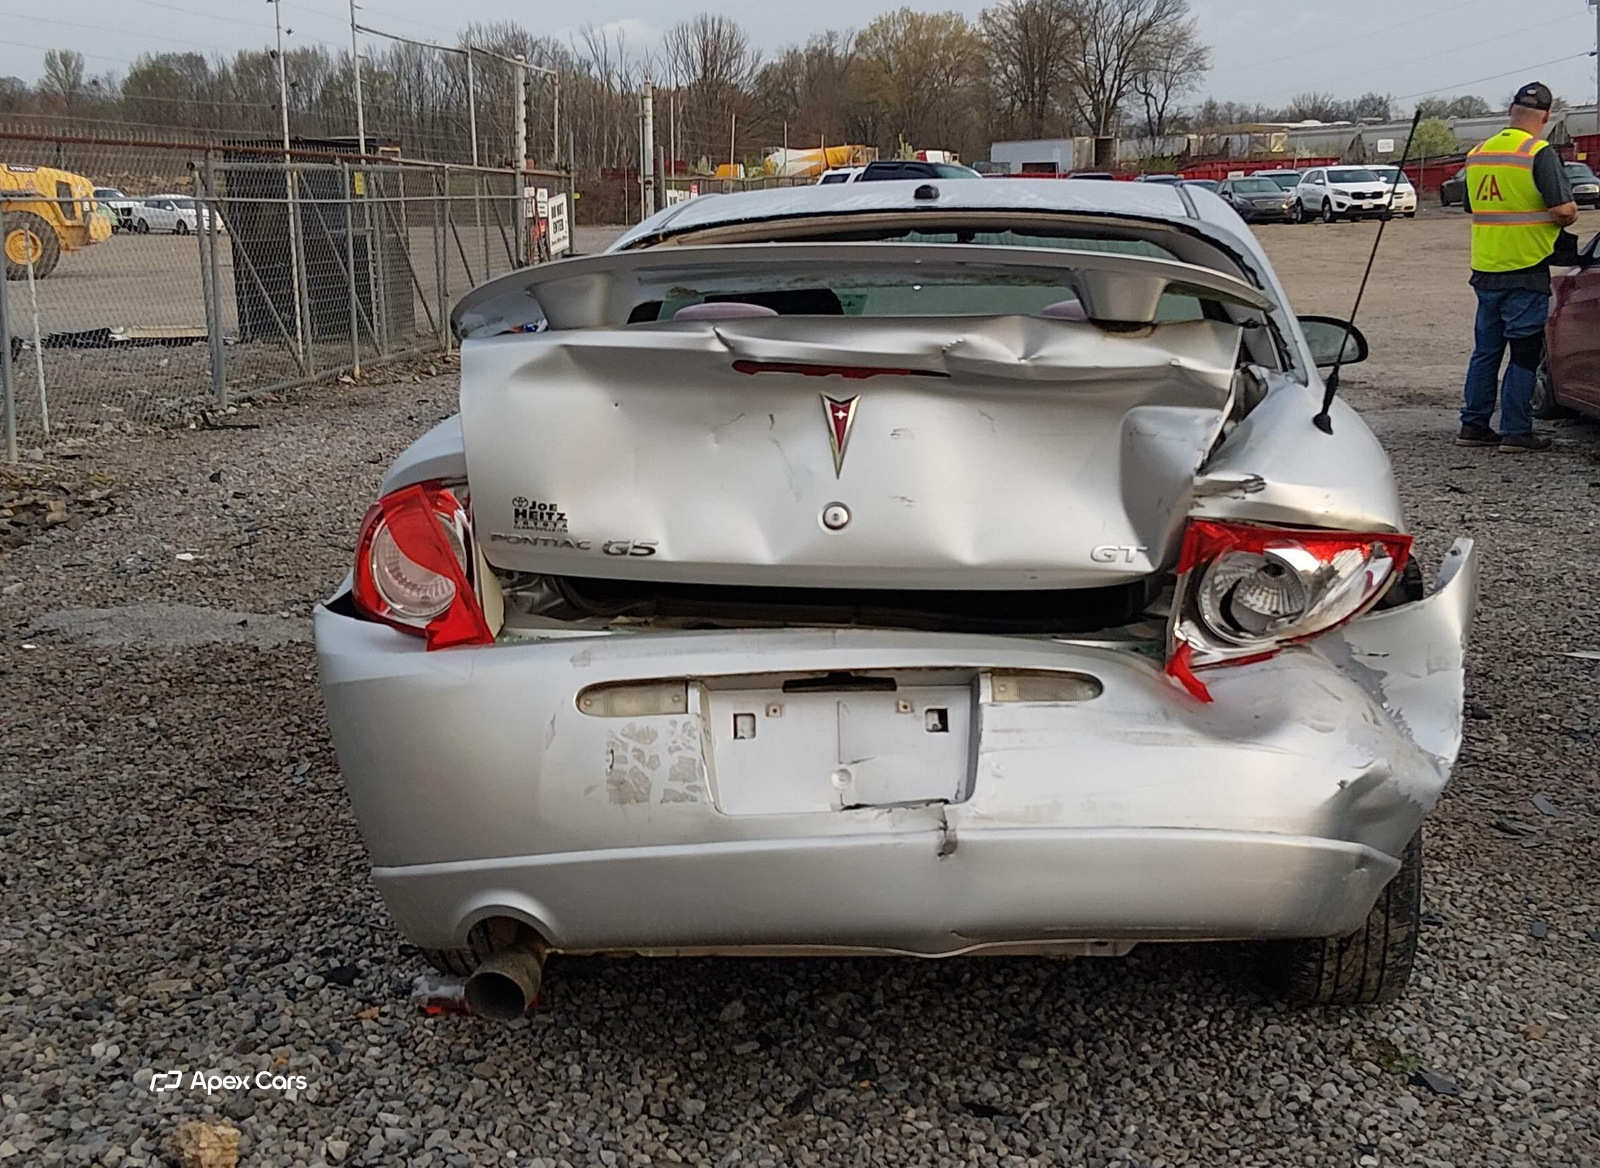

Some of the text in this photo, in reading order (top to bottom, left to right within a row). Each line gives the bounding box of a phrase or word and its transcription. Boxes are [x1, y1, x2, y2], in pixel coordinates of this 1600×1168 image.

[529, 500, 558, 512] JOE
[514, 508, 568, 521] HEITZ
[490, 532, 659, 557] PONTIAC G5
[1090, 545, 1149, 563] GT
